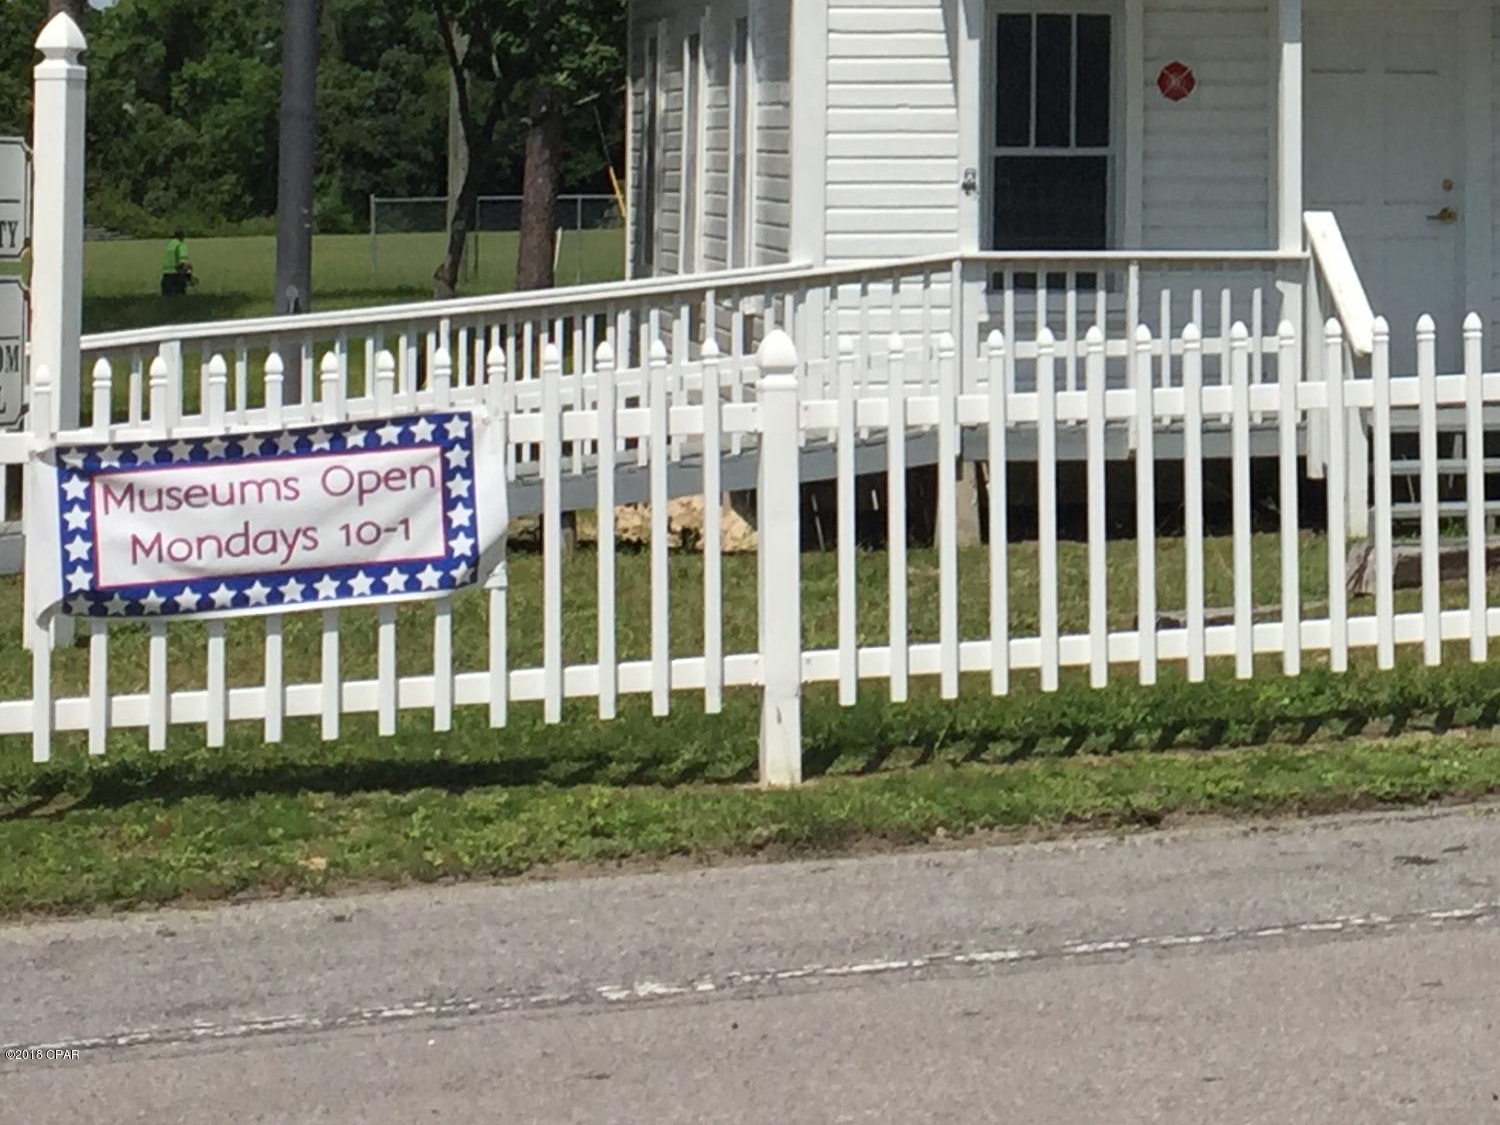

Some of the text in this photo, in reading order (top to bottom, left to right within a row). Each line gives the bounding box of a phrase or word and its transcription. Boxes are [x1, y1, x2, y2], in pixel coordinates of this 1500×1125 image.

[103, 463, 436, 515] Museums Open
[131, 518, 411, 565] Mondays 10-1
